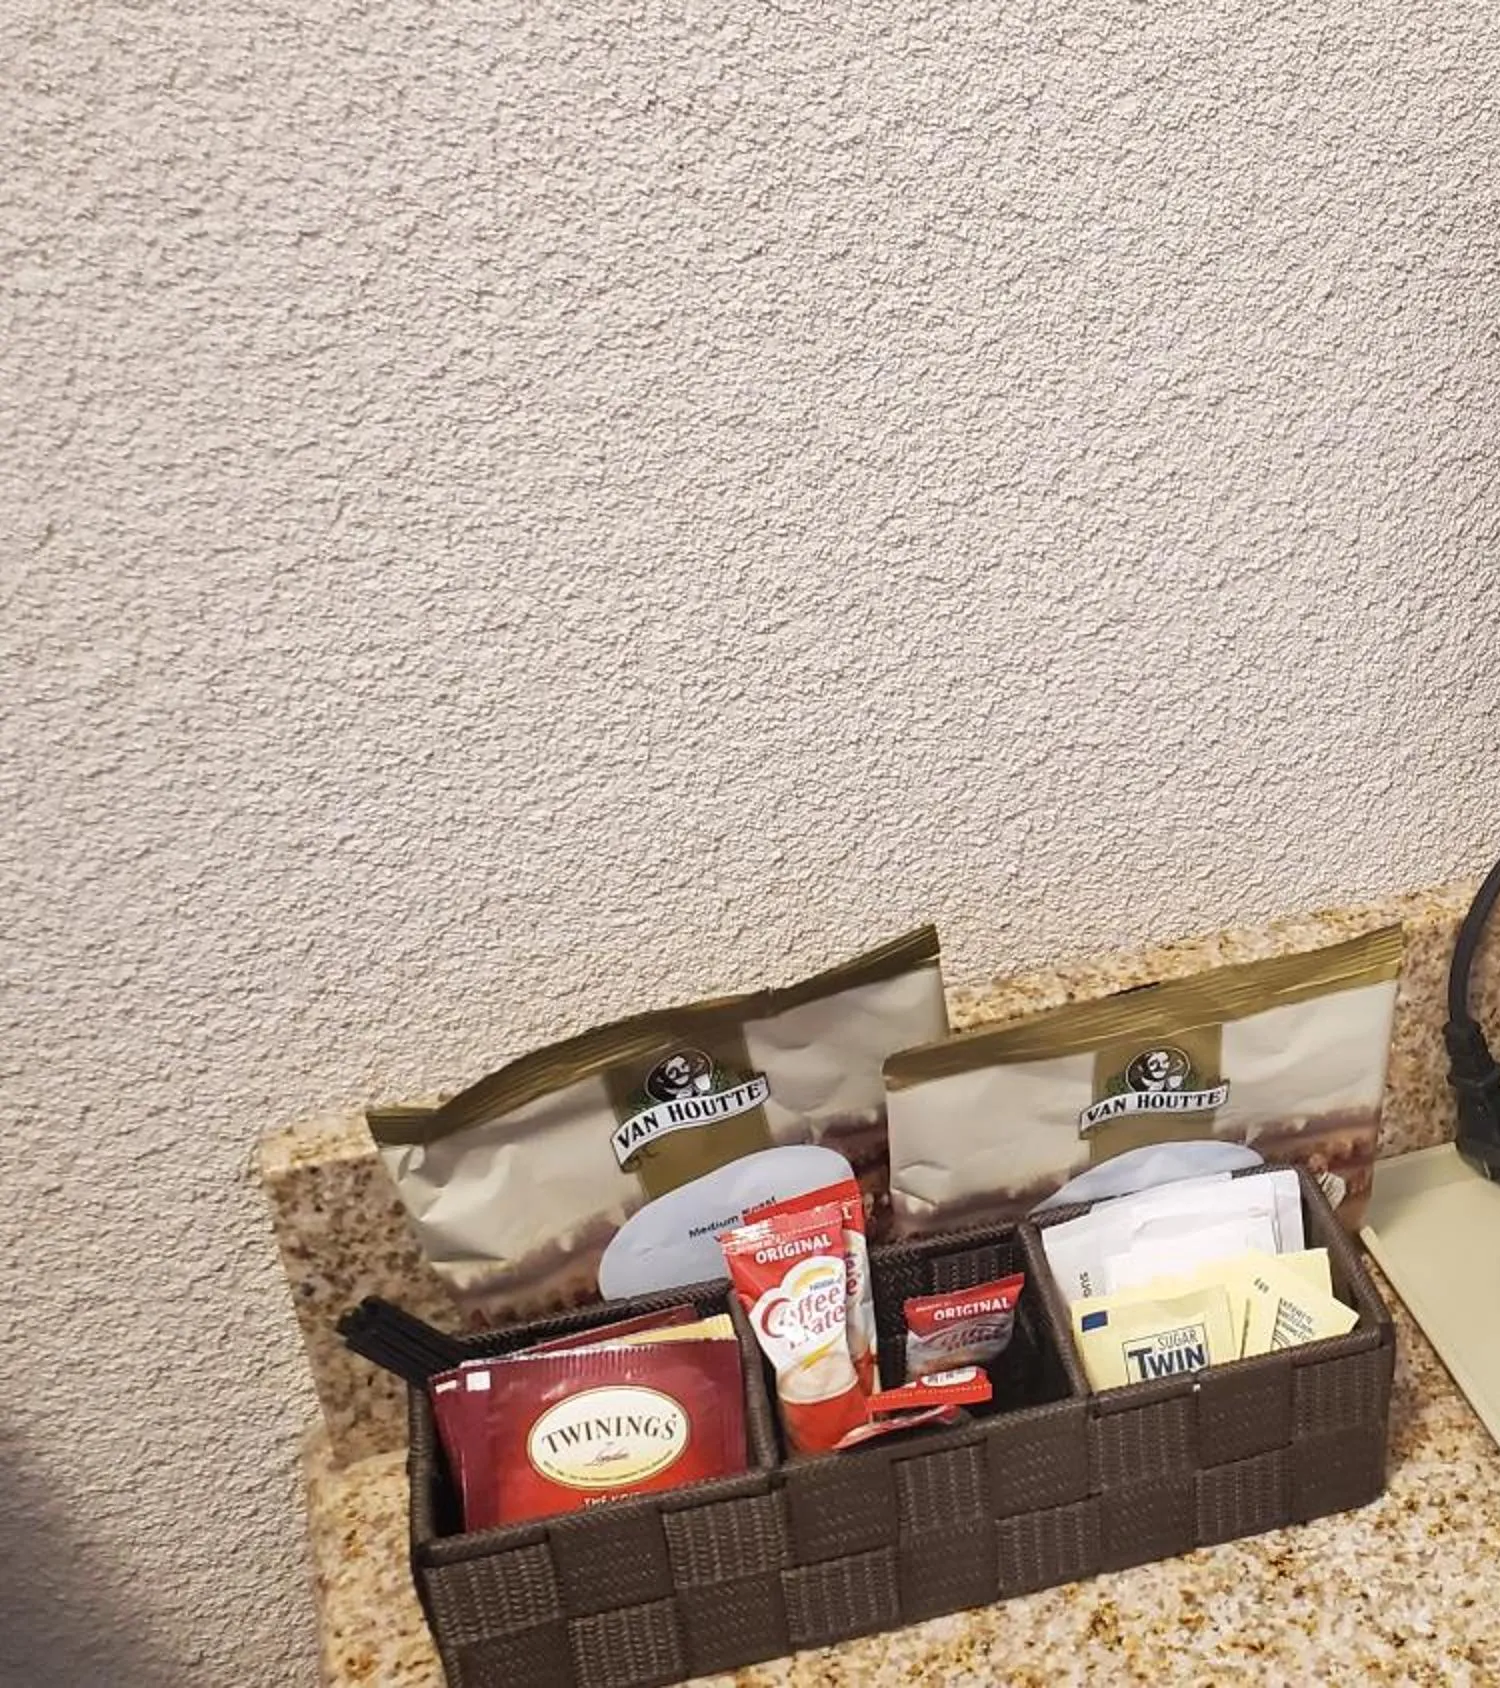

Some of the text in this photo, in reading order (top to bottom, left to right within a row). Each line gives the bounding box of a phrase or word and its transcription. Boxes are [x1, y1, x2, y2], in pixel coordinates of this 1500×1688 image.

[617, 1083, 761, 1149] VAN HOUTTE
[1087, 1091, 1221, 1121] VAN HOUTTE
[688, 1215, 739, 1238] Medium
[755, 1233, 833, 1265] ORIGINAL
[933, 1297, 1011, 1321] ORIGINAL
[1157, 1329, 1199, 1350] SUGAR
[1127, 1344, 1206, 1378] TWIN
[541, 1414, 677, 1454] TWININGS
